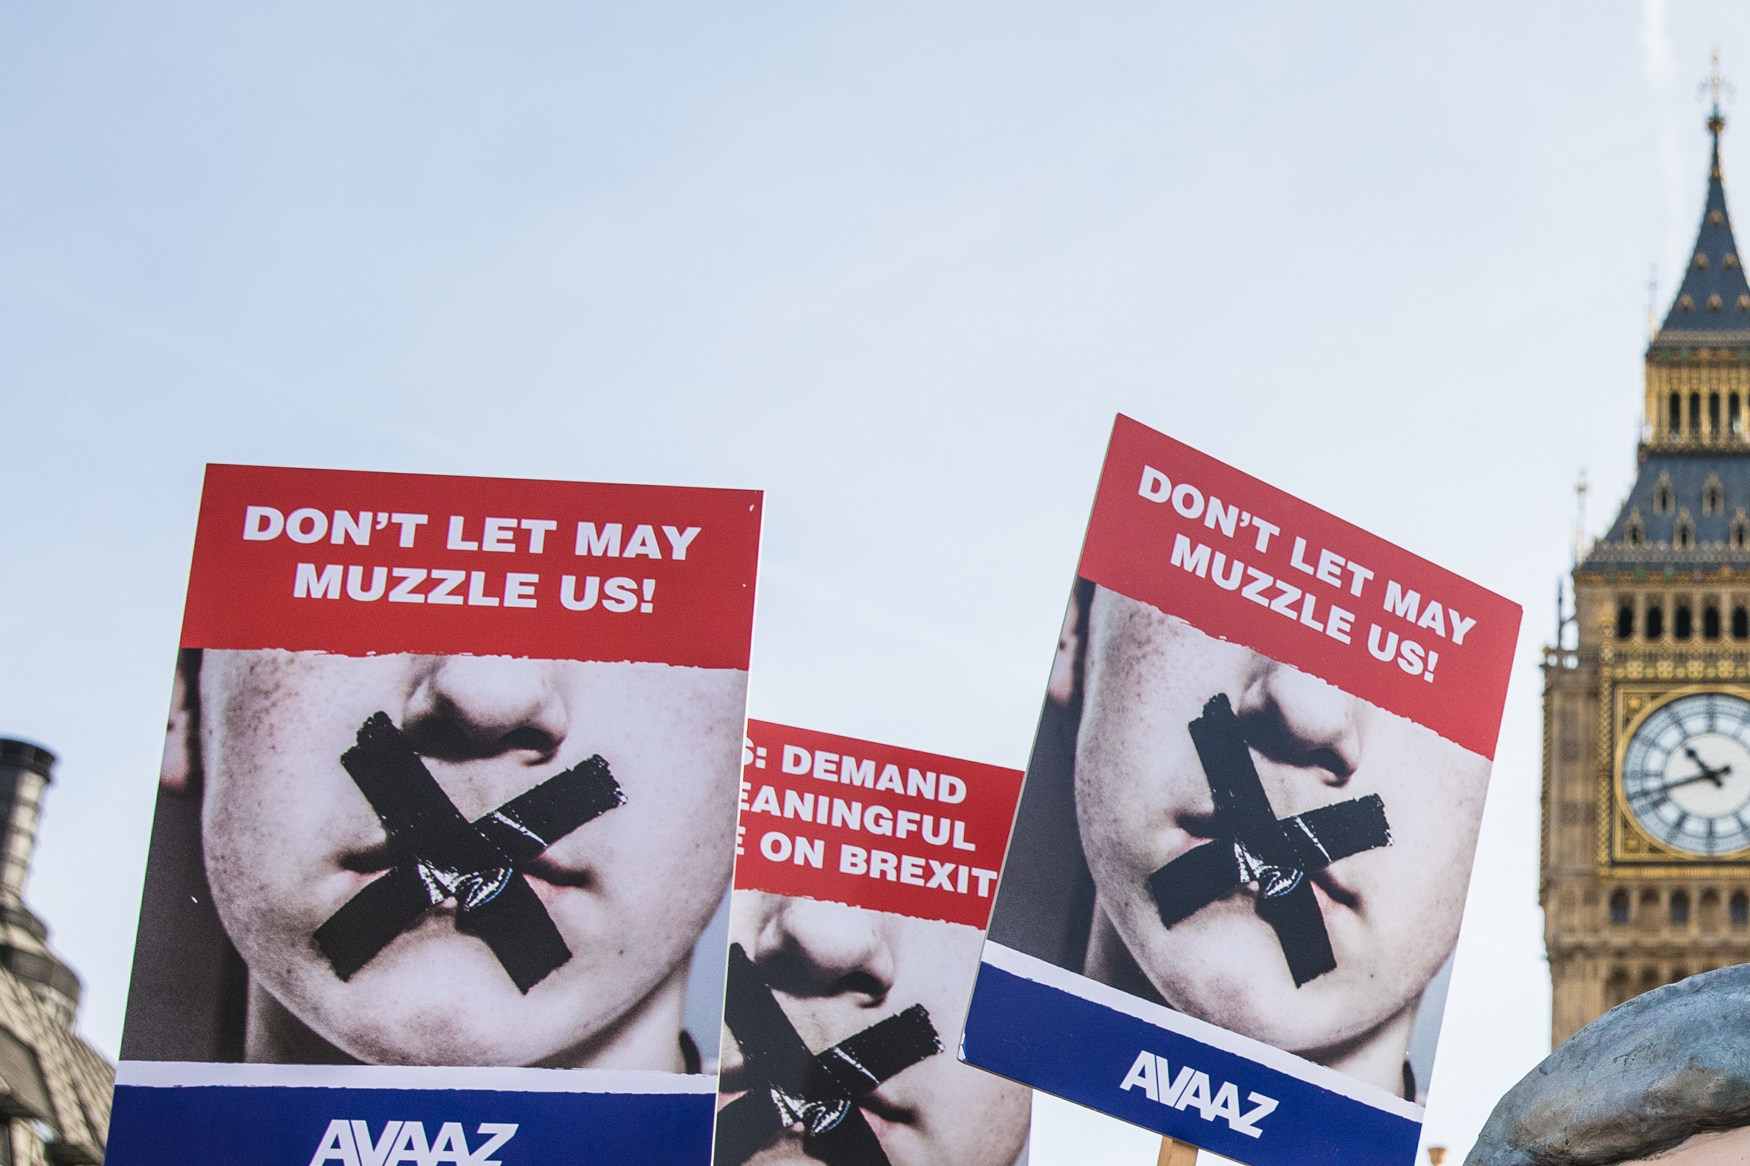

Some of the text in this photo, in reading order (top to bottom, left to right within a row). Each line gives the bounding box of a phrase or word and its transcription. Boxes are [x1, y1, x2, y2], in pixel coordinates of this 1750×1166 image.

[243, 505, 701, 560] DON’T LET MAY
[1137, 464, 1476, 646] DON’T LET MAY
[293, 563, 656, 613] MUZZLE US!
[1170, 533, 1439, 683] MUZZLE US!
[781, 744, 967, 804] DEMAND
[740, 781, 976, 852] ANINGFUL
[760, 831, 825, 869] ON
[839, 843, 998, 898] BREXIT
[1120, 1050, 1280, 1139] AVAAZ
